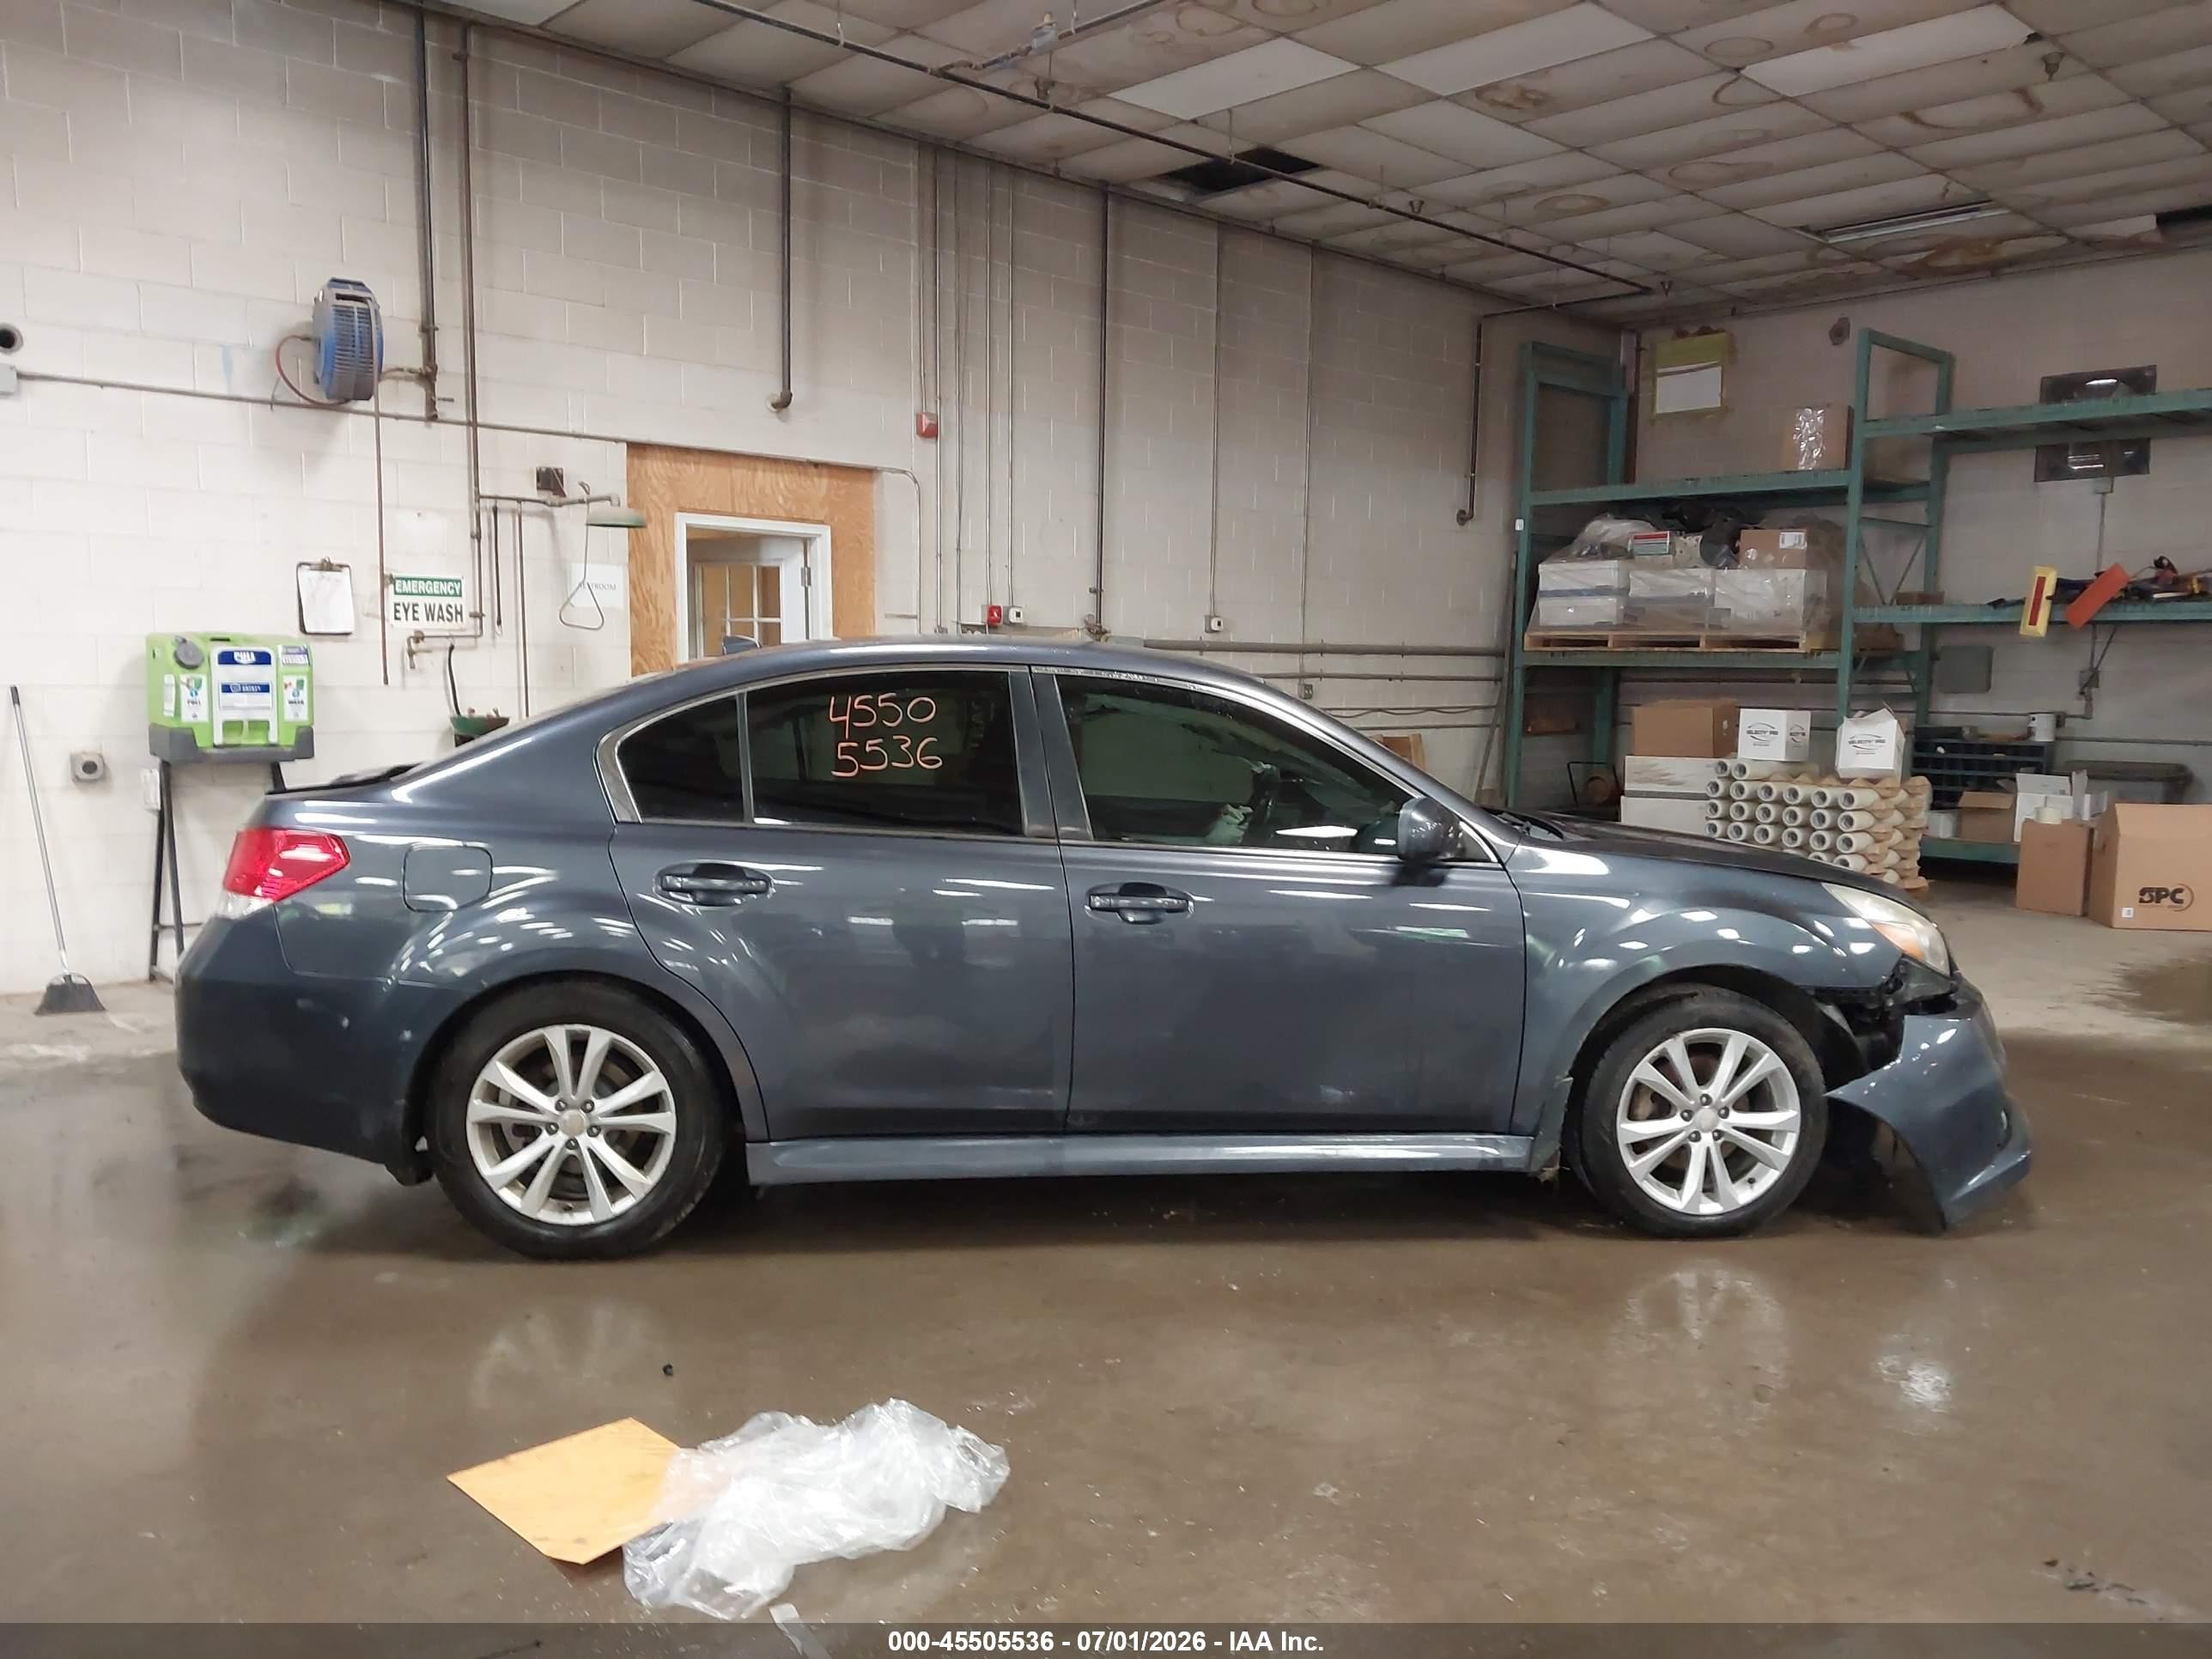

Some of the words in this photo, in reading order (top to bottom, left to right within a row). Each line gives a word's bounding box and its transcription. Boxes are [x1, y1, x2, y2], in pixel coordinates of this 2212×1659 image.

[395, 579, 461, 595] EMERGENCY
[393, 602, 420, 622] EYE
[424, 603, 464, 623] WASH
[830, 692, 936, 739] 4550
[830, 735, 943, 777] 5536
[2138, 886, 2185, 904] SPC
